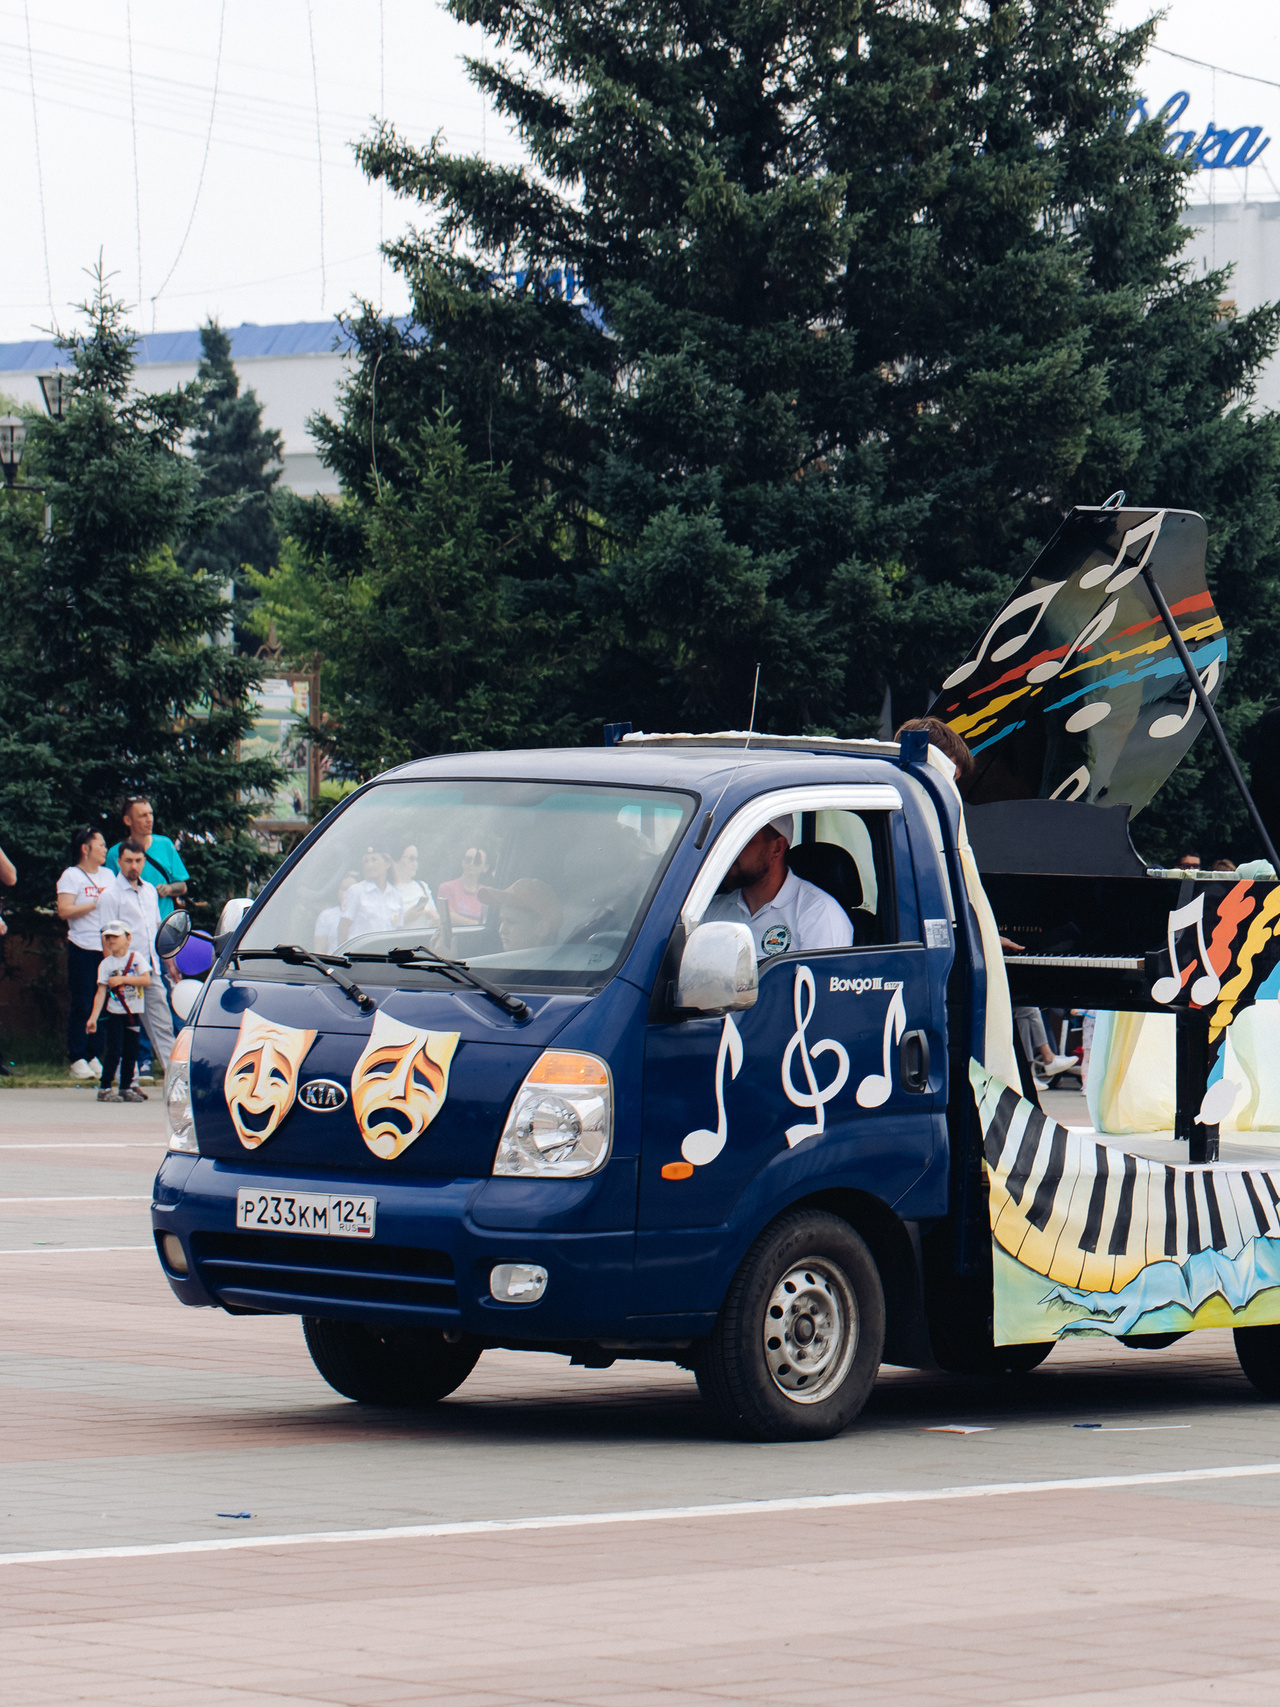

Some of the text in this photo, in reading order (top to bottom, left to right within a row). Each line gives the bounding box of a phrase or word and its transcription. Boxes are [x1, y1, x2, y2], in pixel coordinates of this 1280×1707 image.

[306, 1086, 338, 1105] KIA
[332, 1200, 367, 1224] 124
[339, 1223, 358, 1233] RUS
